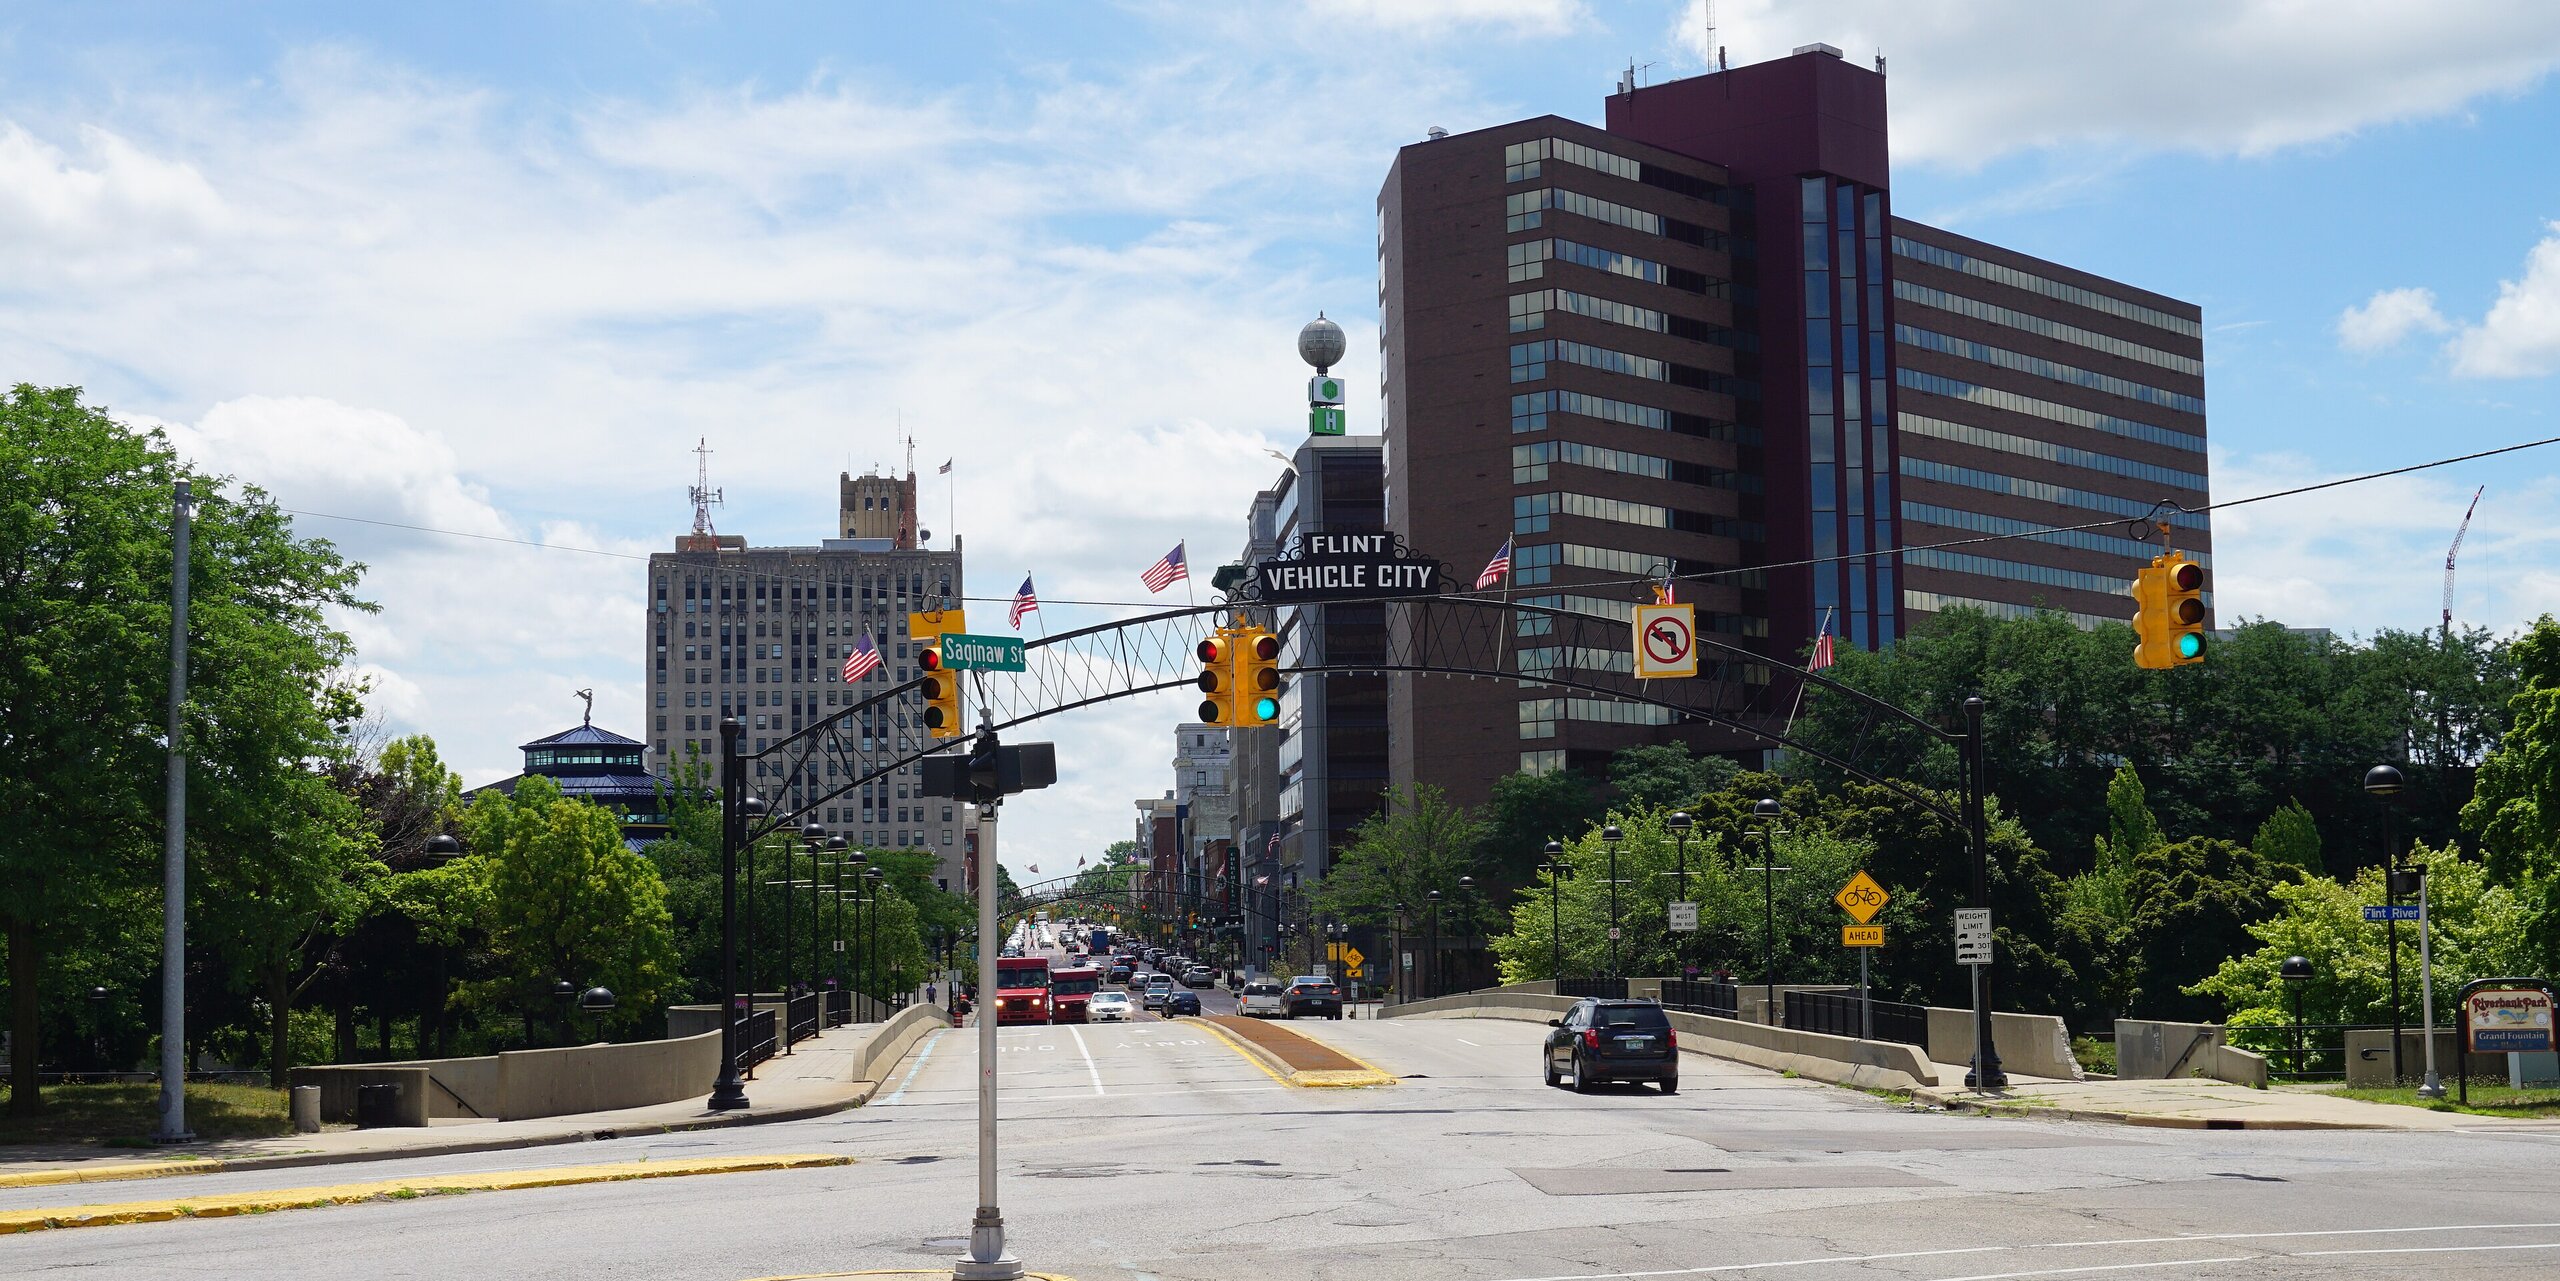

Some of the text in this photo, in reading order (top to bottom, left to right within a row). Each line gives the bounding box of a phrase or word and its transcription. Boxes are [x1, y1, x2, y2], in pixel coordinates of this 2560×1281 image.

[1312, 535, 1386, 554] FLINT
[1267, 565, 1432, 590] VEHICLE CITY
[945, 637, 1024, 668] Saginaw St
[2364, 908, 2418, 918] Flint River
[1848, 931, 1879, 941] AHEAD
[1977, 952, 1991, 960] 37T
[2472, 997, 2547, 1013] Riverbank Park
[2478, 1032, 2545, 1040] Grand Fountain
